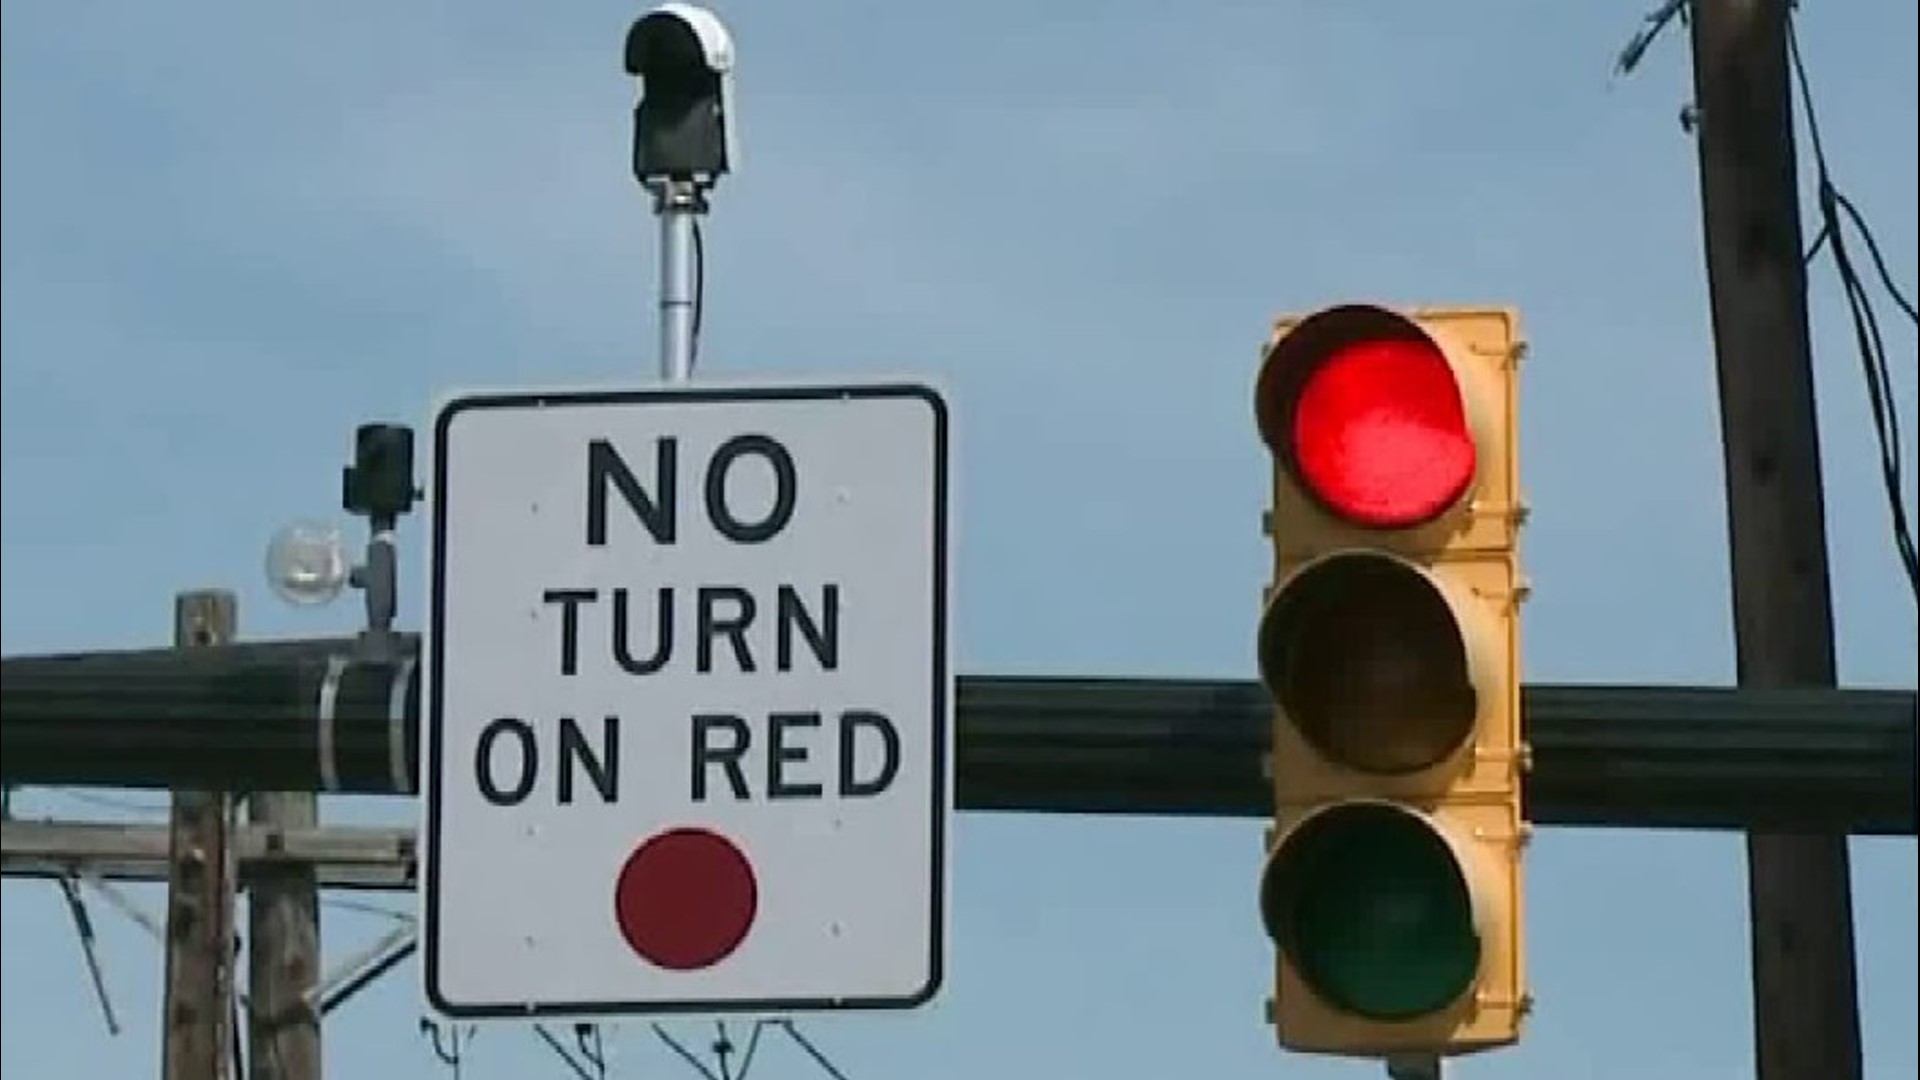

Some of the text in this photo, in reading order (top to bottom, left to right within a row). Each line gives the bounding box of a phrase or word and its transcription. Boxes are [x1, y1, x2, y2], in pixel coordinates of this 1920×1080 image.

[586, 434, 797, 546] NO
[543, 583, 839, 676] TURN
[474, 710, 901, 806] ON RED
